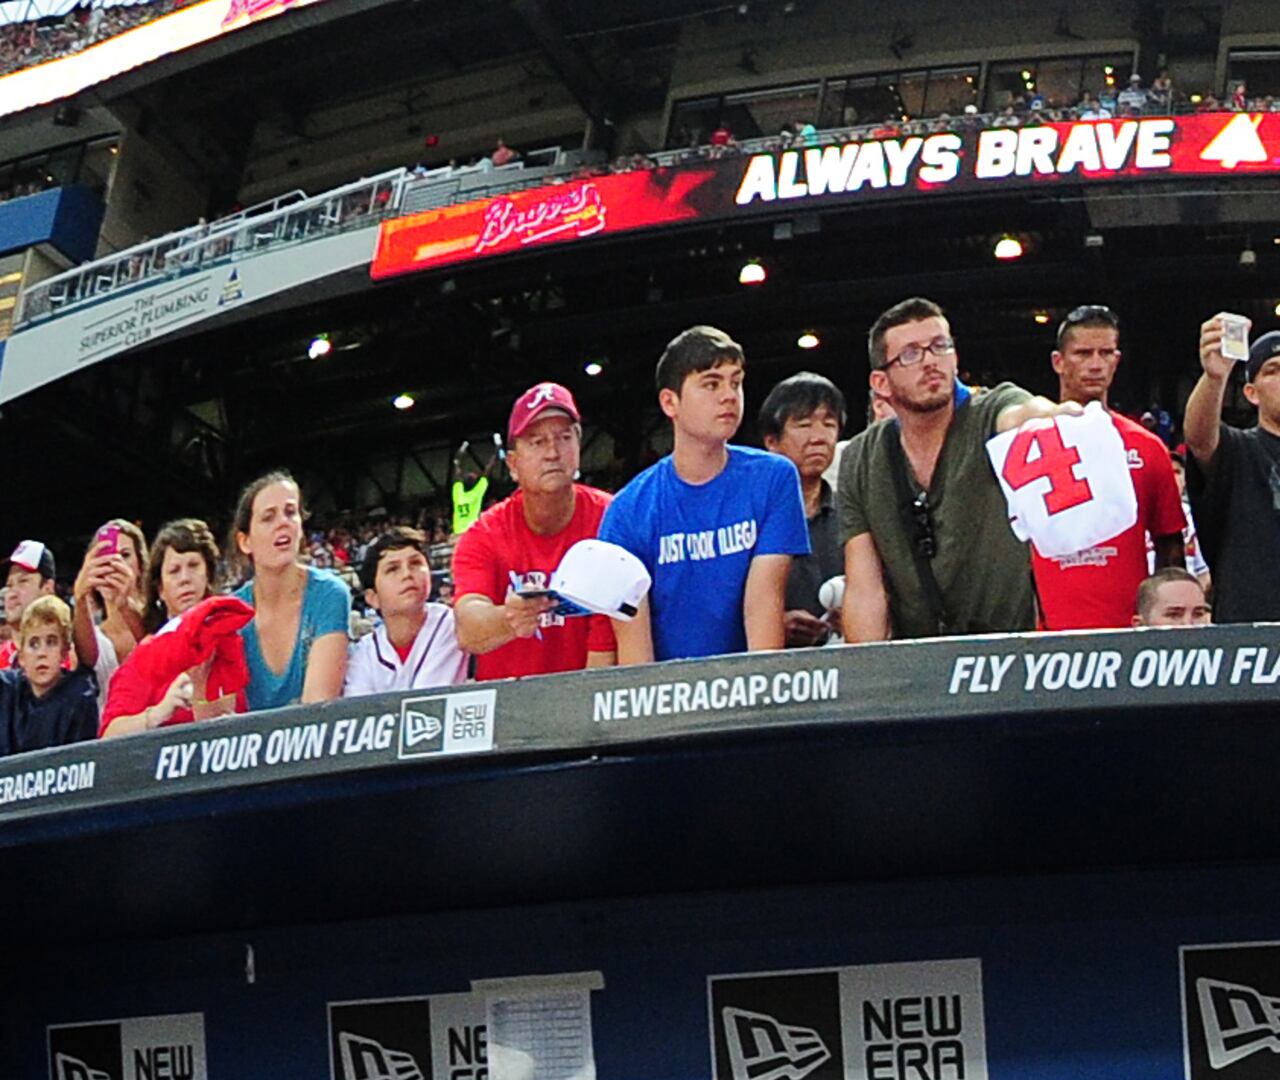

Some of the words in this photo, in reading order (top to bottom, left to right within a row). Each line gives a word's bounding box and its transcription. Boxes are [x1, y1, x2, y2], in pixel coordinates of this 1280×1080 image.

[736, 133, 961, 204] ALWAYS
[975, 119, 1175, 179] BRAVE
[477, 184, 600, 253] Braves
[79, 316, 137, 351] SUPERIOR
[139, 287, 209, 327] PLUMBING
[1002, 416, 1095, 516] 4
[658, 533, 685, 565] JUST
[594, 668, 839, 723] NEWERACAP.COM
[949, 654, 1016, 694] FLY
[1023, 650, 1122, 692] YOUR
[1130, 647, 1222, 689] OWN
[451, 721, 486, 741] ERA
[452, 705, 488, 724] NEW
[155, 741, 195, 781] FLY
[199, 732, 262, 774] YOUR
[265, 724, 325, 764] OWN
[329, 715, 395, 757] FLAG
[862, 994, 963, 1042] NEW
[447, 1025, 487, 1066] NE
